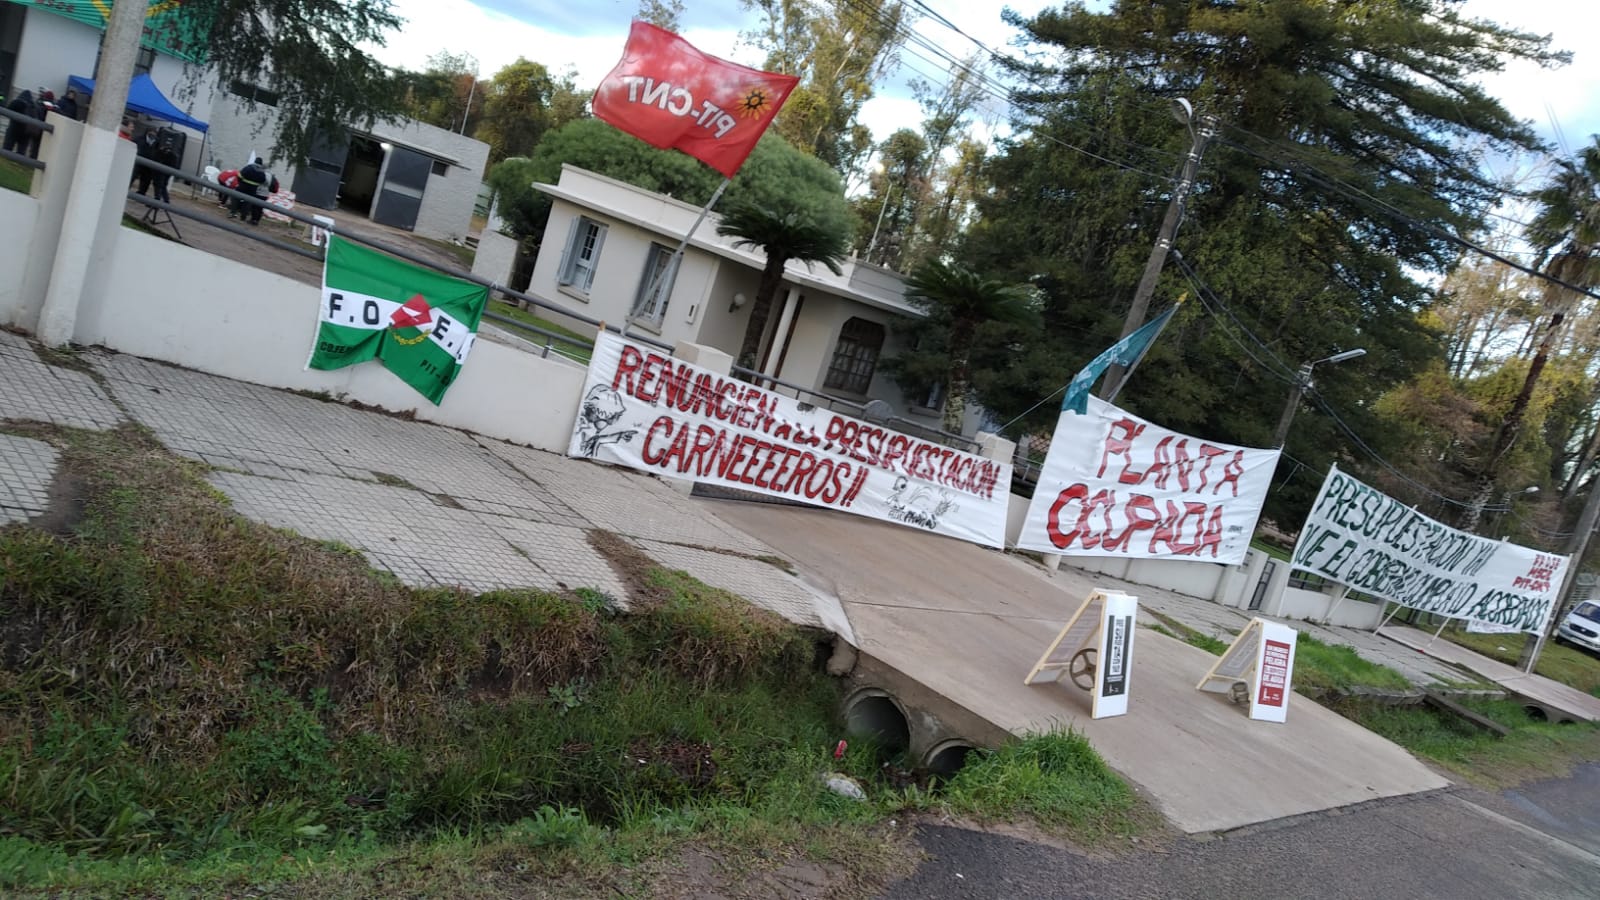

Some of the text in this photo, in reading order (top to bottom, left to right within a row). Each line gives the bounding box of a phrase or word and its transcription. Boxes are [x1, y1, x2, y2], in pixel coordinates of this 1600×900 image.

[1097, 417, 1244, 497] PLANTA
[1047, 483, 1223, 558] OCUPADA
[1318, 539, 1359, 578] EL
